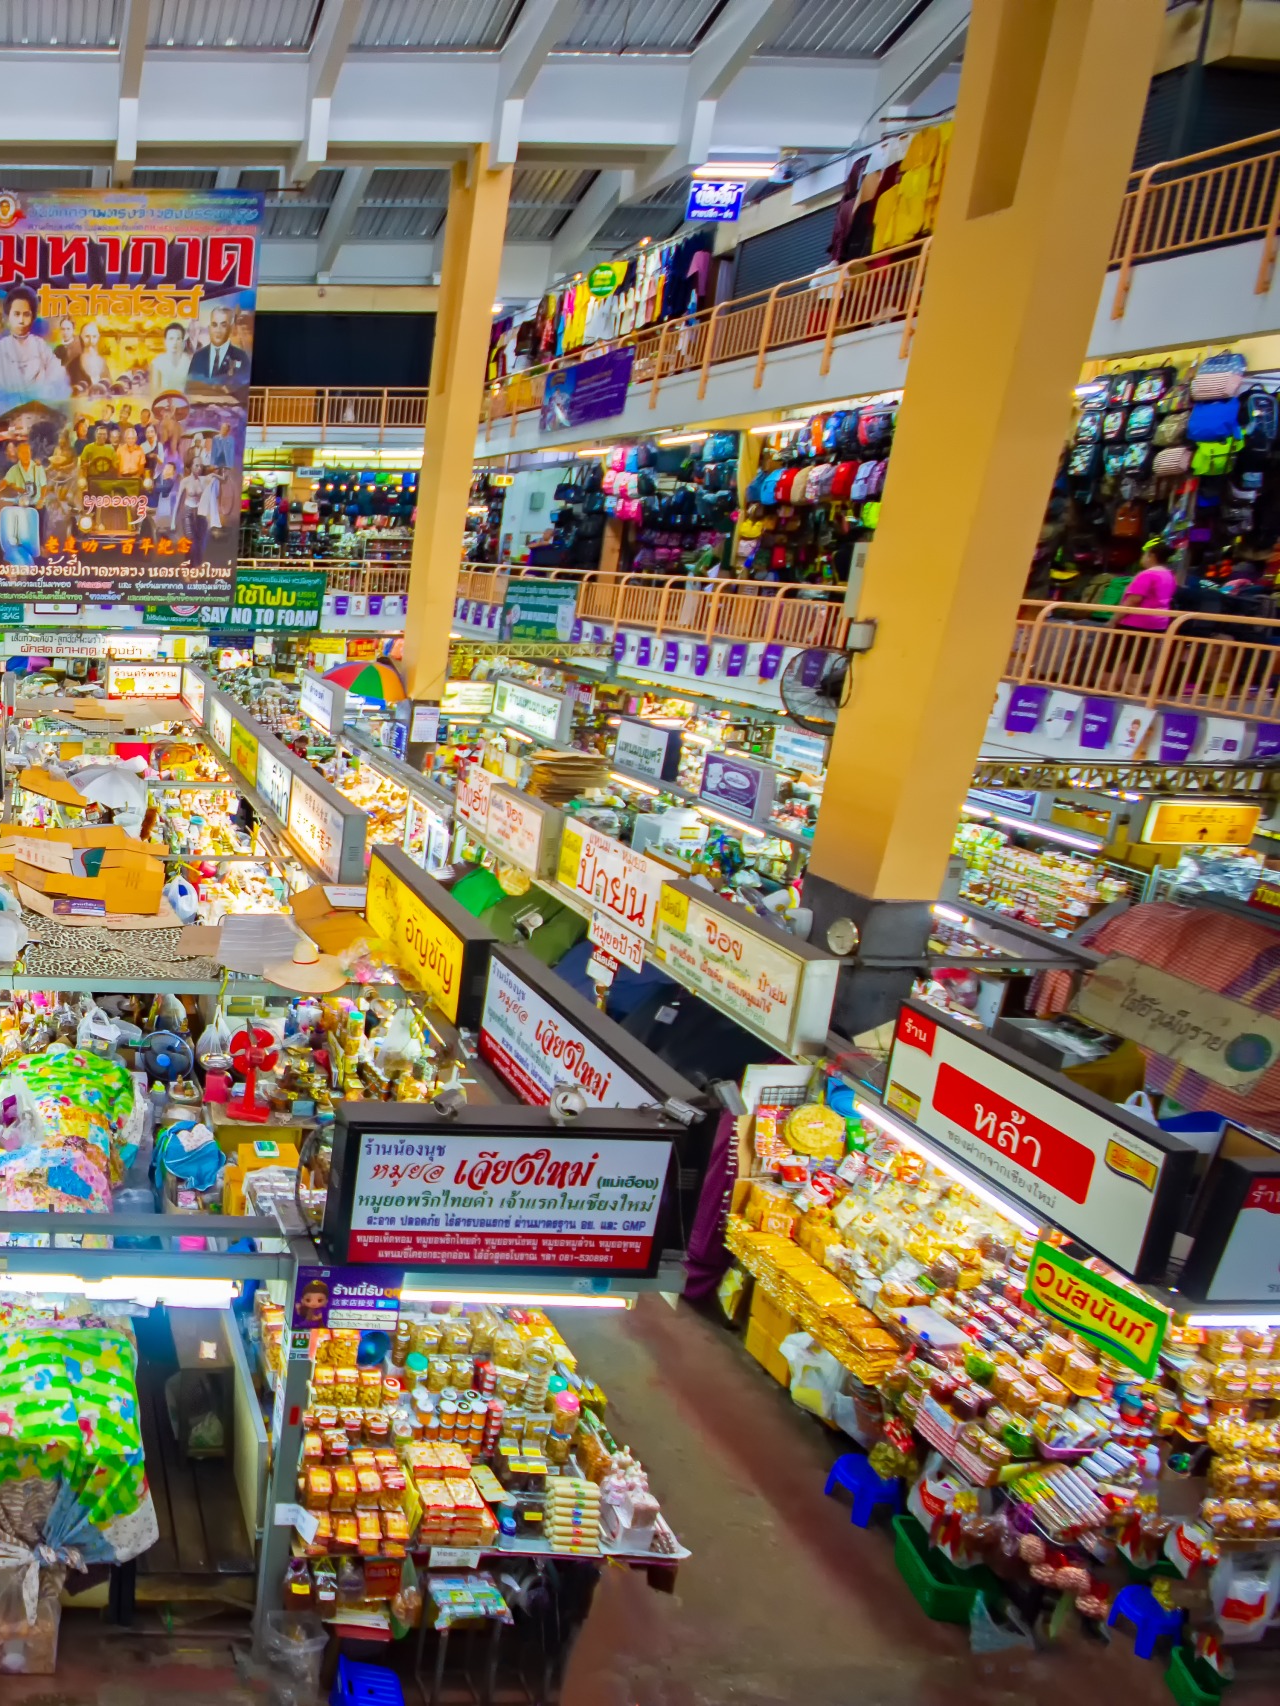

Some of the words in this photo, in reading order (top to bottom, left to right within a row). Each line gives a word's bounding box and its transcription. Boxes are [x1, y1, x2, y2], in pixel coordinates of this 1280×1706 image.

[2, 612, 20, 620] BAG
[201, 606, 229, 624] SAY
[231, 607, 253, 625] NO
[255, 608, 274, 625] TO
[277, 609, 318, 627] FOAM
[577, 843, 648, 928] ป้าย่น
[904, 1017, 928, 1043] ร้าน
[972, 1101, 1042, 1168] หล้า
[365, 1138, 447, 1162] ร้านน้องนุช
[369, 1162, 445, 1188] หมูยอ
[454, 1149, 600, 1191] เจียงใหม่
[947, 1129, 1057, 1210] ของฝากจากเชียงใหม่
[358, 1190, 494, 1214] หมูยอพริกไทยดำ
[500, 1190, 657, 1212] เจ้าแรกในเชียงใหม่
[367, 1215, 396, 1226] สะอาด
[401, 1213, 440, 1227] ปลอดภัย
[445, 1213, 511, 1228] ไร้สารบอแรกซ์
[515, 1215, 576, 1232] ผ่านมาตรฐาน
[581, 1220, 595, 1230] อย.
[601, 1221, 618, 1231] และ
[622, 1220, 646, 1231] GMP
[416, 1233, 481, 1248] หมูยอพริกไทยดำ
[333, 1282, 383, 1297] ร้านนี้รับ
[1035, 1262, 1154, 1346] วนัสนันท์
